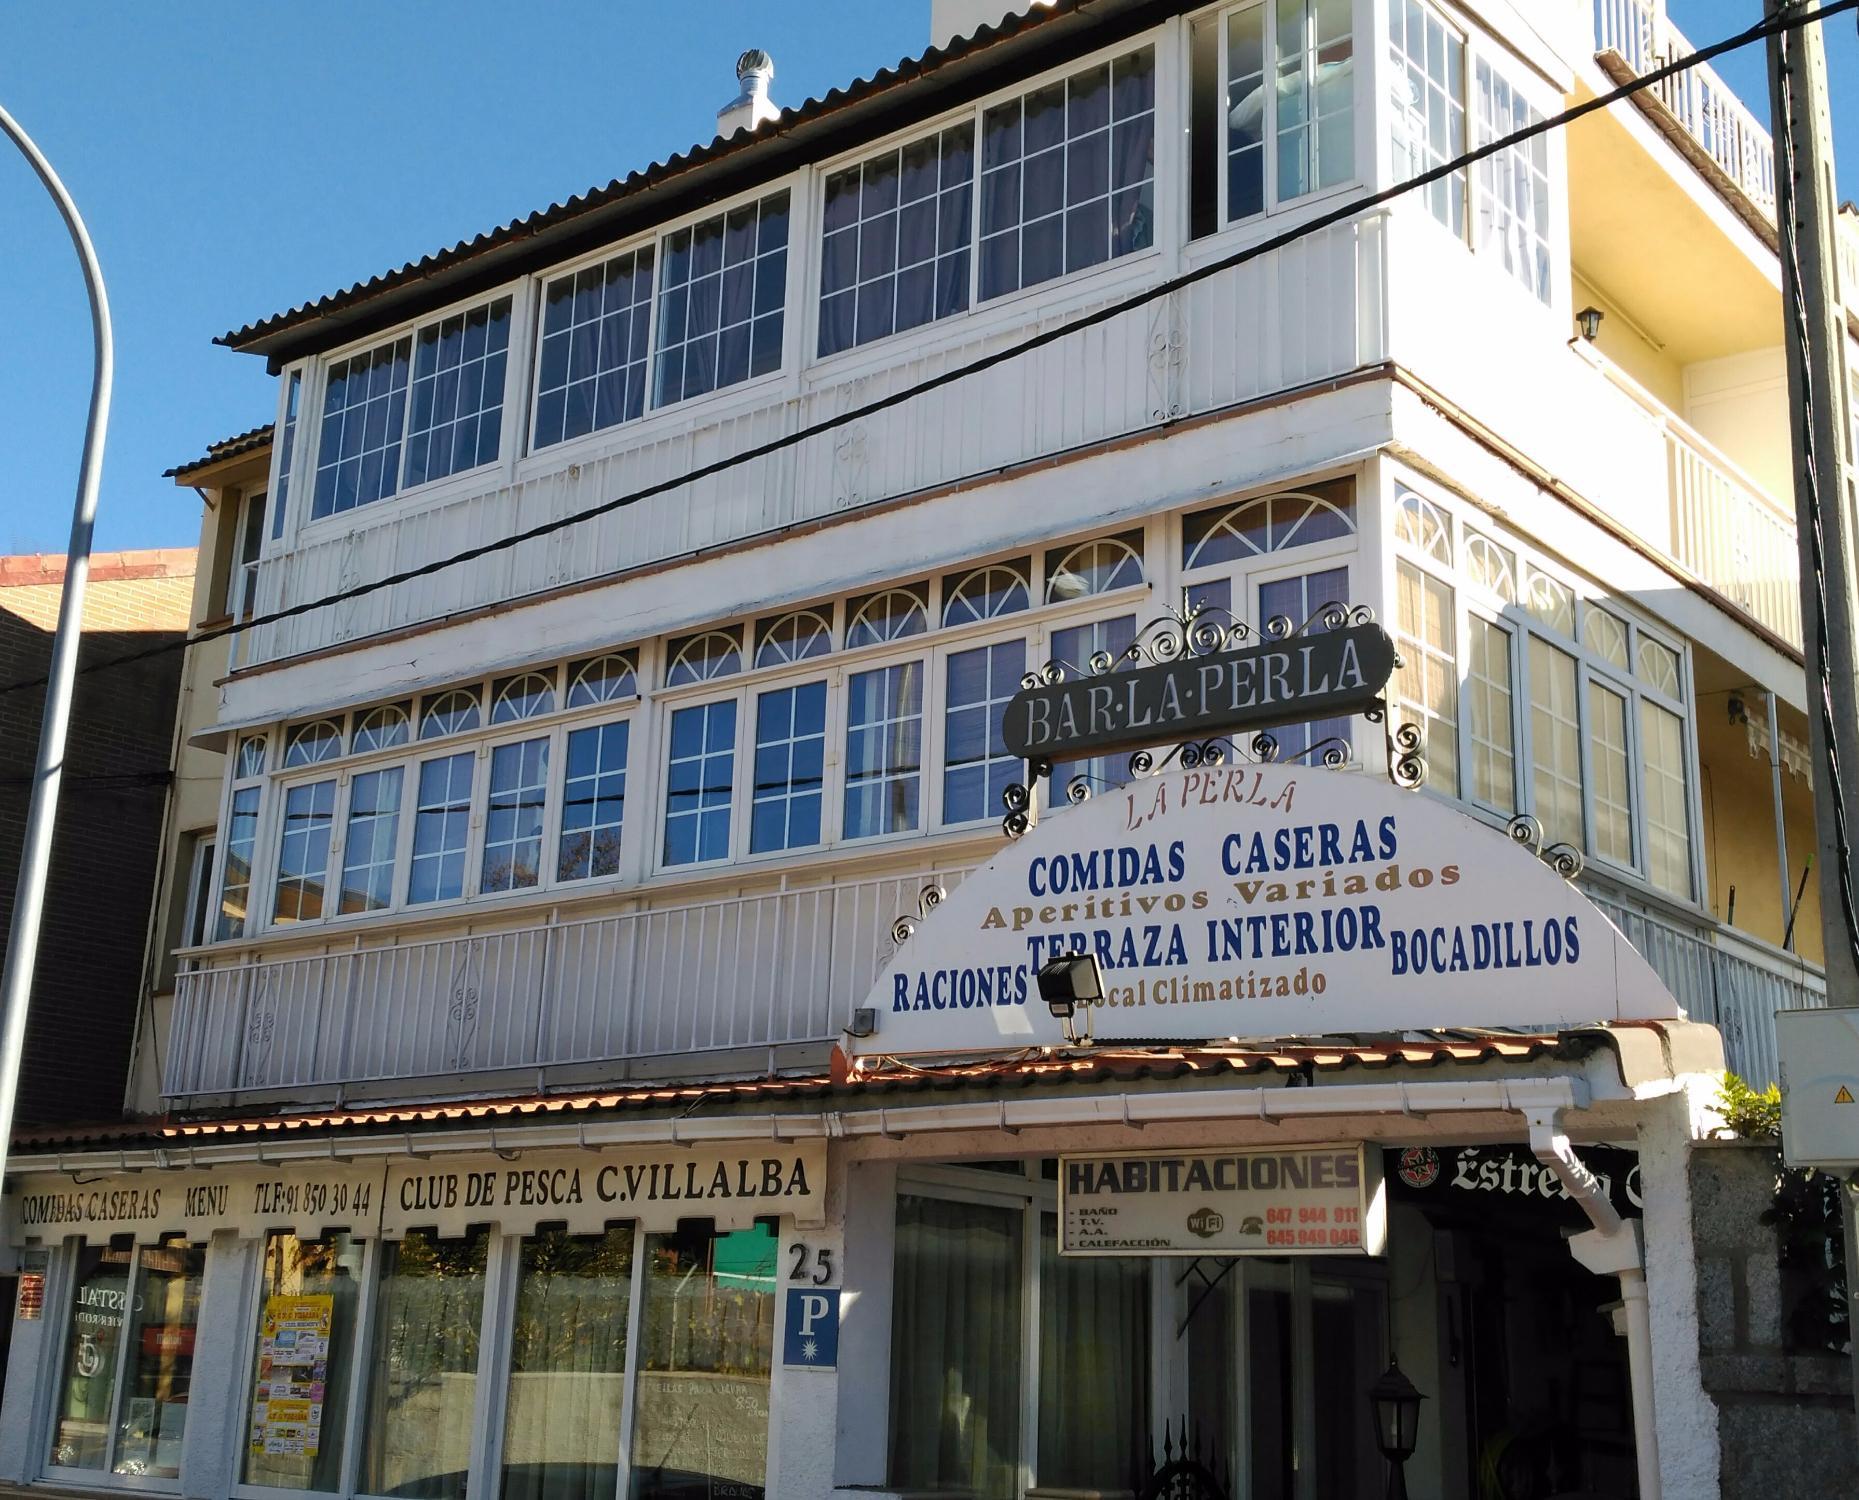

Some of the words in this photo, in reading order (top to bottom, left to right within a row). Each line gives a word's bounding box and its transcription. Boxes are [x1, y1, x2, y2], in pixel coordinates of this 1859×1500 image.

[1127, 782, 1167, 831] LA
[1182, 769, 1296, 813] PERLA
[1028, 840, 1186, 897] COMIDAS
[1221, 815, 1397, 876] CASERAS
[980, 889, 1208, 931] Aperitivos
[1235, 862, 1460, 905] Variados
[1207, 904, 1385, 962] INTERIOR
[1392, 915, 1580, 975] BOCADILLOS
[893, 964, 1028, 1012] RACIONES
[1153, 969, 1327, 1005] Climatizado
[400, 1174, 459, 1211] CLUB
[466, 1172, 496, 1208] DE
[504, 1167, 583, 1206] PESCA
[1069, 1154, 1359, 1194] HABITACIONES
[21, 1192, 83, 1225] COMIDAS
[86, 1188, 161, 1222] CASERAS
[184, 1185, 230, 1218] MENU
[303, 1182, 326, 1213] 850
[330, 1182, 348, 1214] 30
[352, 1182, 372, 1217] 44
[1266, 1207, 1292, 1224] 647
[1299, 1207, 1327, 1223] 944
[1334, 1207, 1359, 1223] 911
[1266, 1229, 1294, 1246] 645
[788, 1243, 833, 1286] 25
[798, 1295, 829, 1337] P
